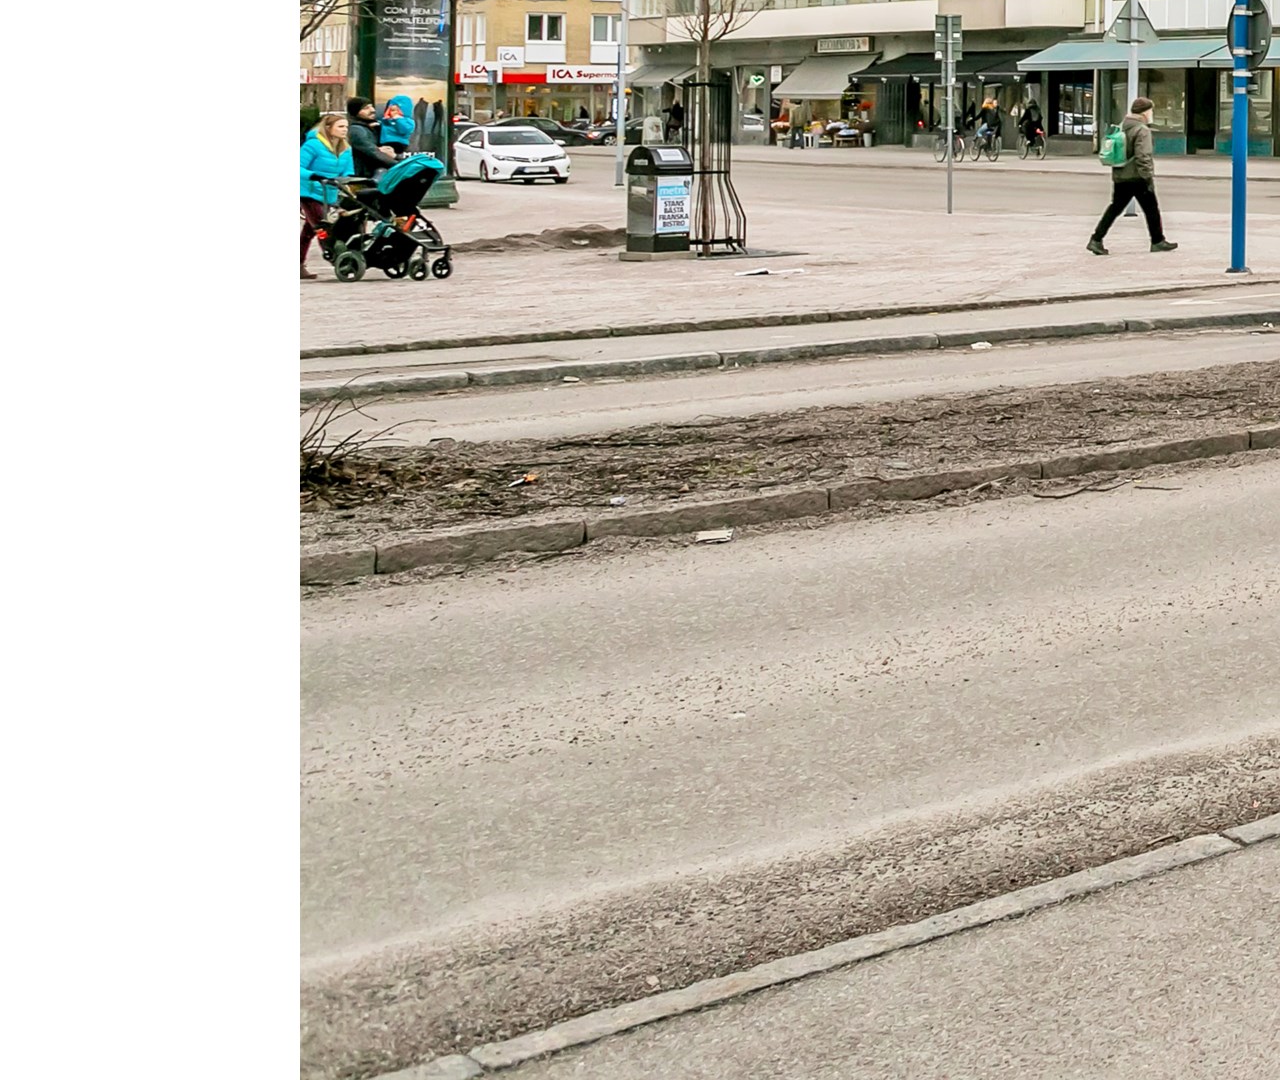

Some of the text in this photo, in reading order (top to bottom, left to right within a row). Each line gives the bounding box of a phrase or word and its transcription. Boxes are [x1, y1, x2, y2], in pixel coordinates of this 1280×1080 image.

[384, 6, 408, 15] COM
[499, 52, 518, 61] ICA
[471, 64, 488, 74] ICA
[552, 69, 618, 79] ICA Superma
